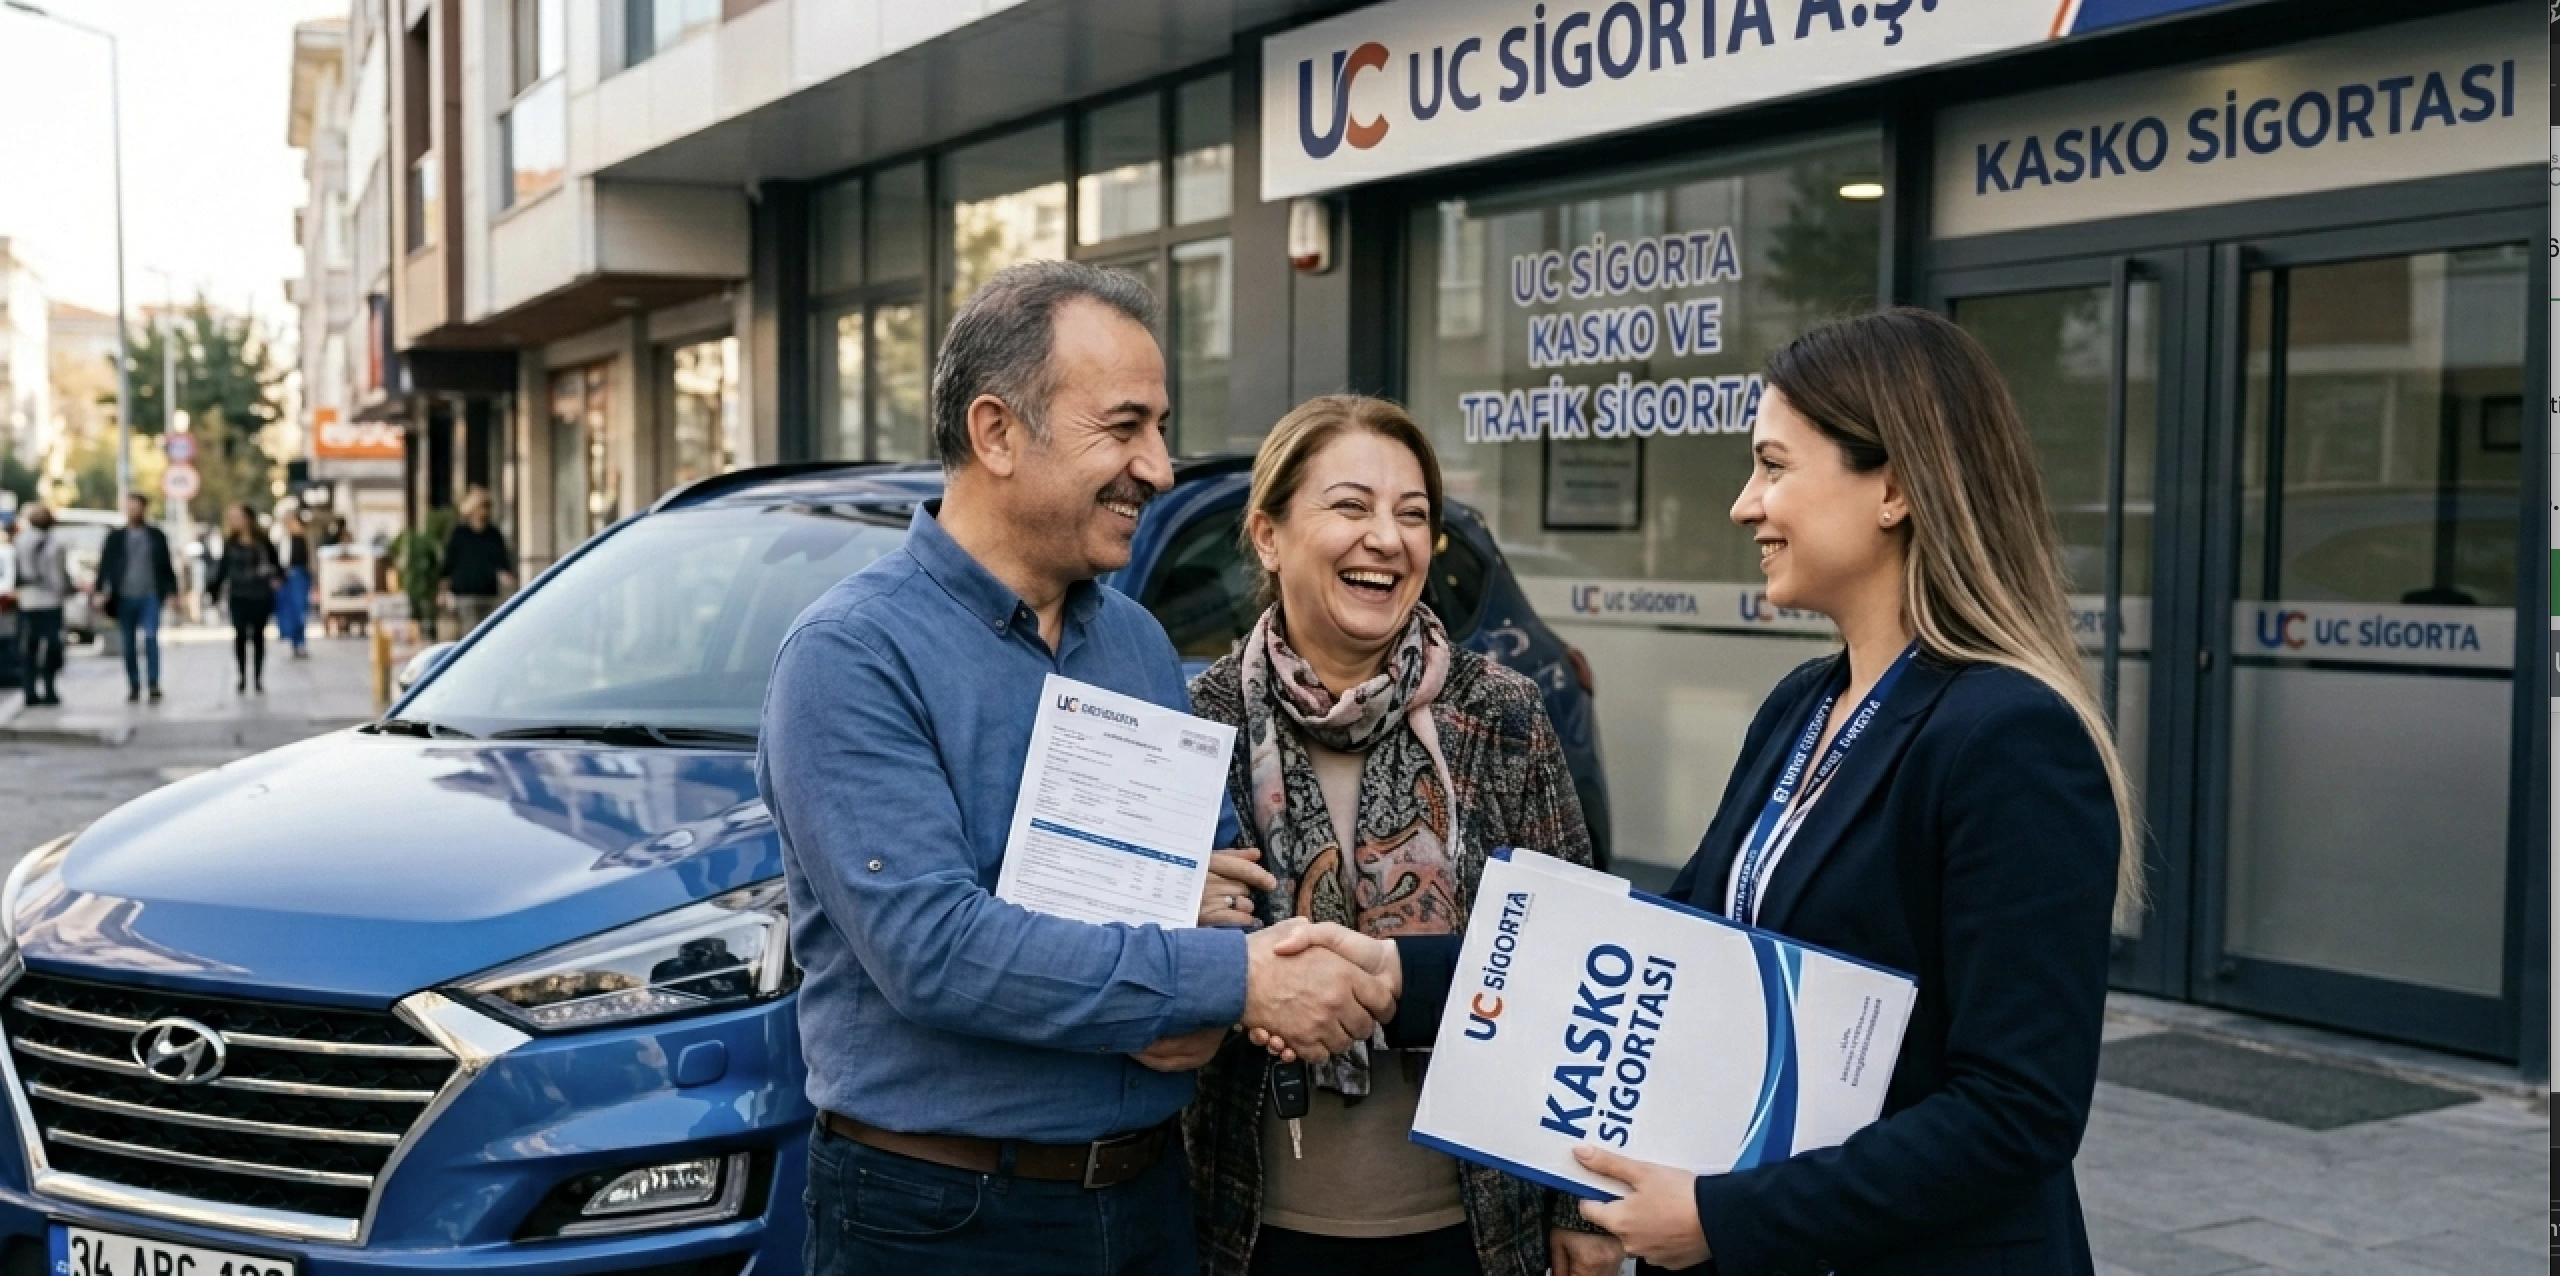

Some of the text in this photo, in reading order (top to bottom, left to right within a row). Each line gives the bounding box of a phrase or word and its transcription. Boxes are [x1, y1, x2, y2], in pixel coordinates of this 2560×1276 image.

[1299, 41, 1390, 159] UC
[1409, 37, 1481, 121] UC
[1976, 59, 2515, 195] KASKO SİGORTASI
[1513, 229, 1739, 304] UC SİGORTA
[1530, 300, 1721, 366] KASKO VE
[1461, 377, 1588, 440] TRAFİK
[1572, 586, 1600, 614] UC
[1604, 592, 1624, 612] UC
[2257, 611, 2480, 651] UC UC SİGORTA
[1464, 992, 1504, 1041] UC
[1540, 943, 1634, 1139] KASKO
[1598, 955, 1676, 1148] SİGORTASI
